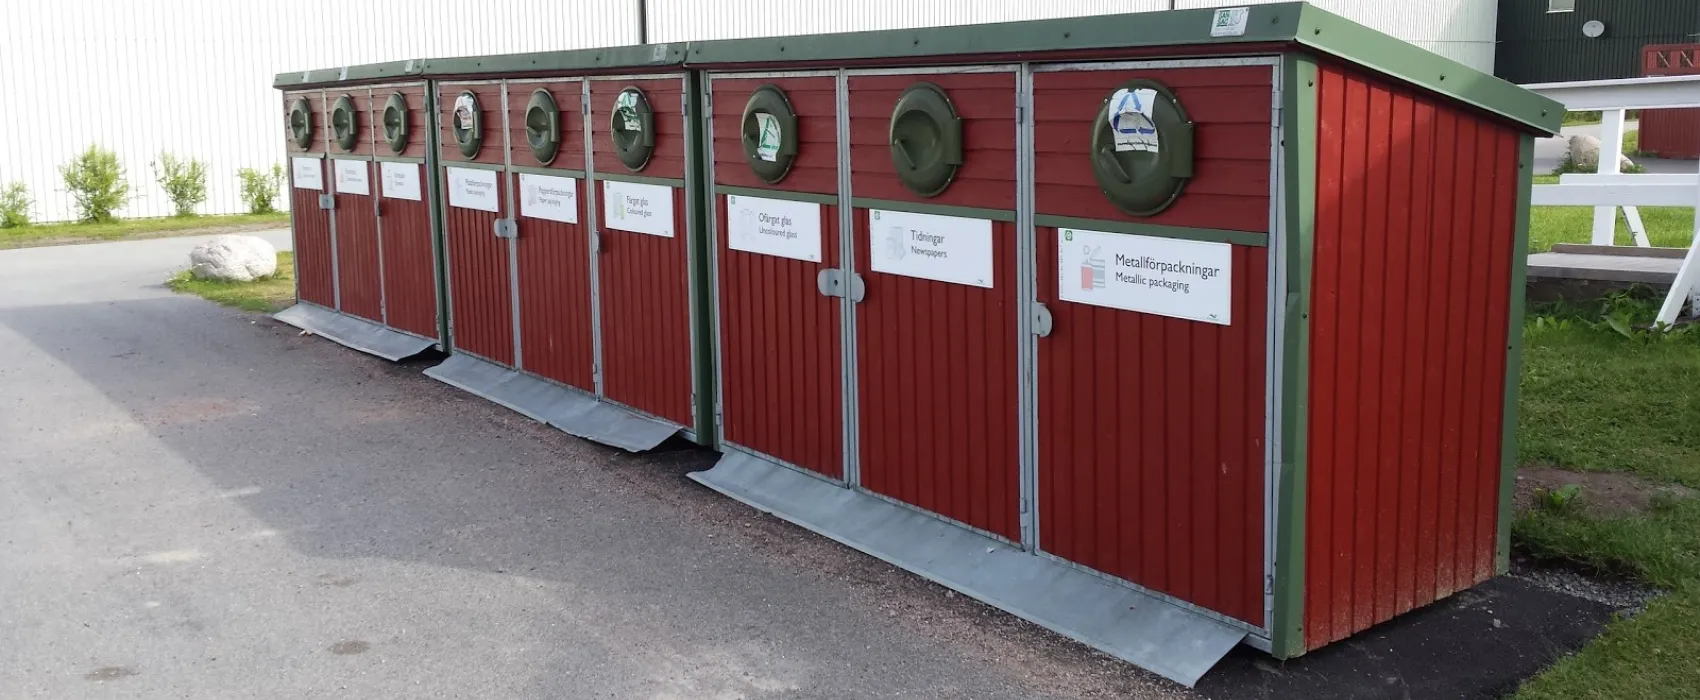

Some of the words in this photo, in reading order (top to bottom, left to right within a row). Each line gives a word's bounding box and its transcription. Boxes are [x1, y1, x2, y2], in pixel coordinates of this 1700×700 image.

[758, 212, 780, 227] Ofärgat
[780, 215, 793, 228] glas
[758, 225, 786, 238] Uncoloured
[786, 230, 798, 240] glass
[910, 229, 946, 247] Tidningar
[910, 245, 948, 259] Newspapers
[1115, 253, 1220, 280] Metallförpackningar
[1115, 272, 1147, 285] Metallic
[1148, 278, 1190, 294] packaging
